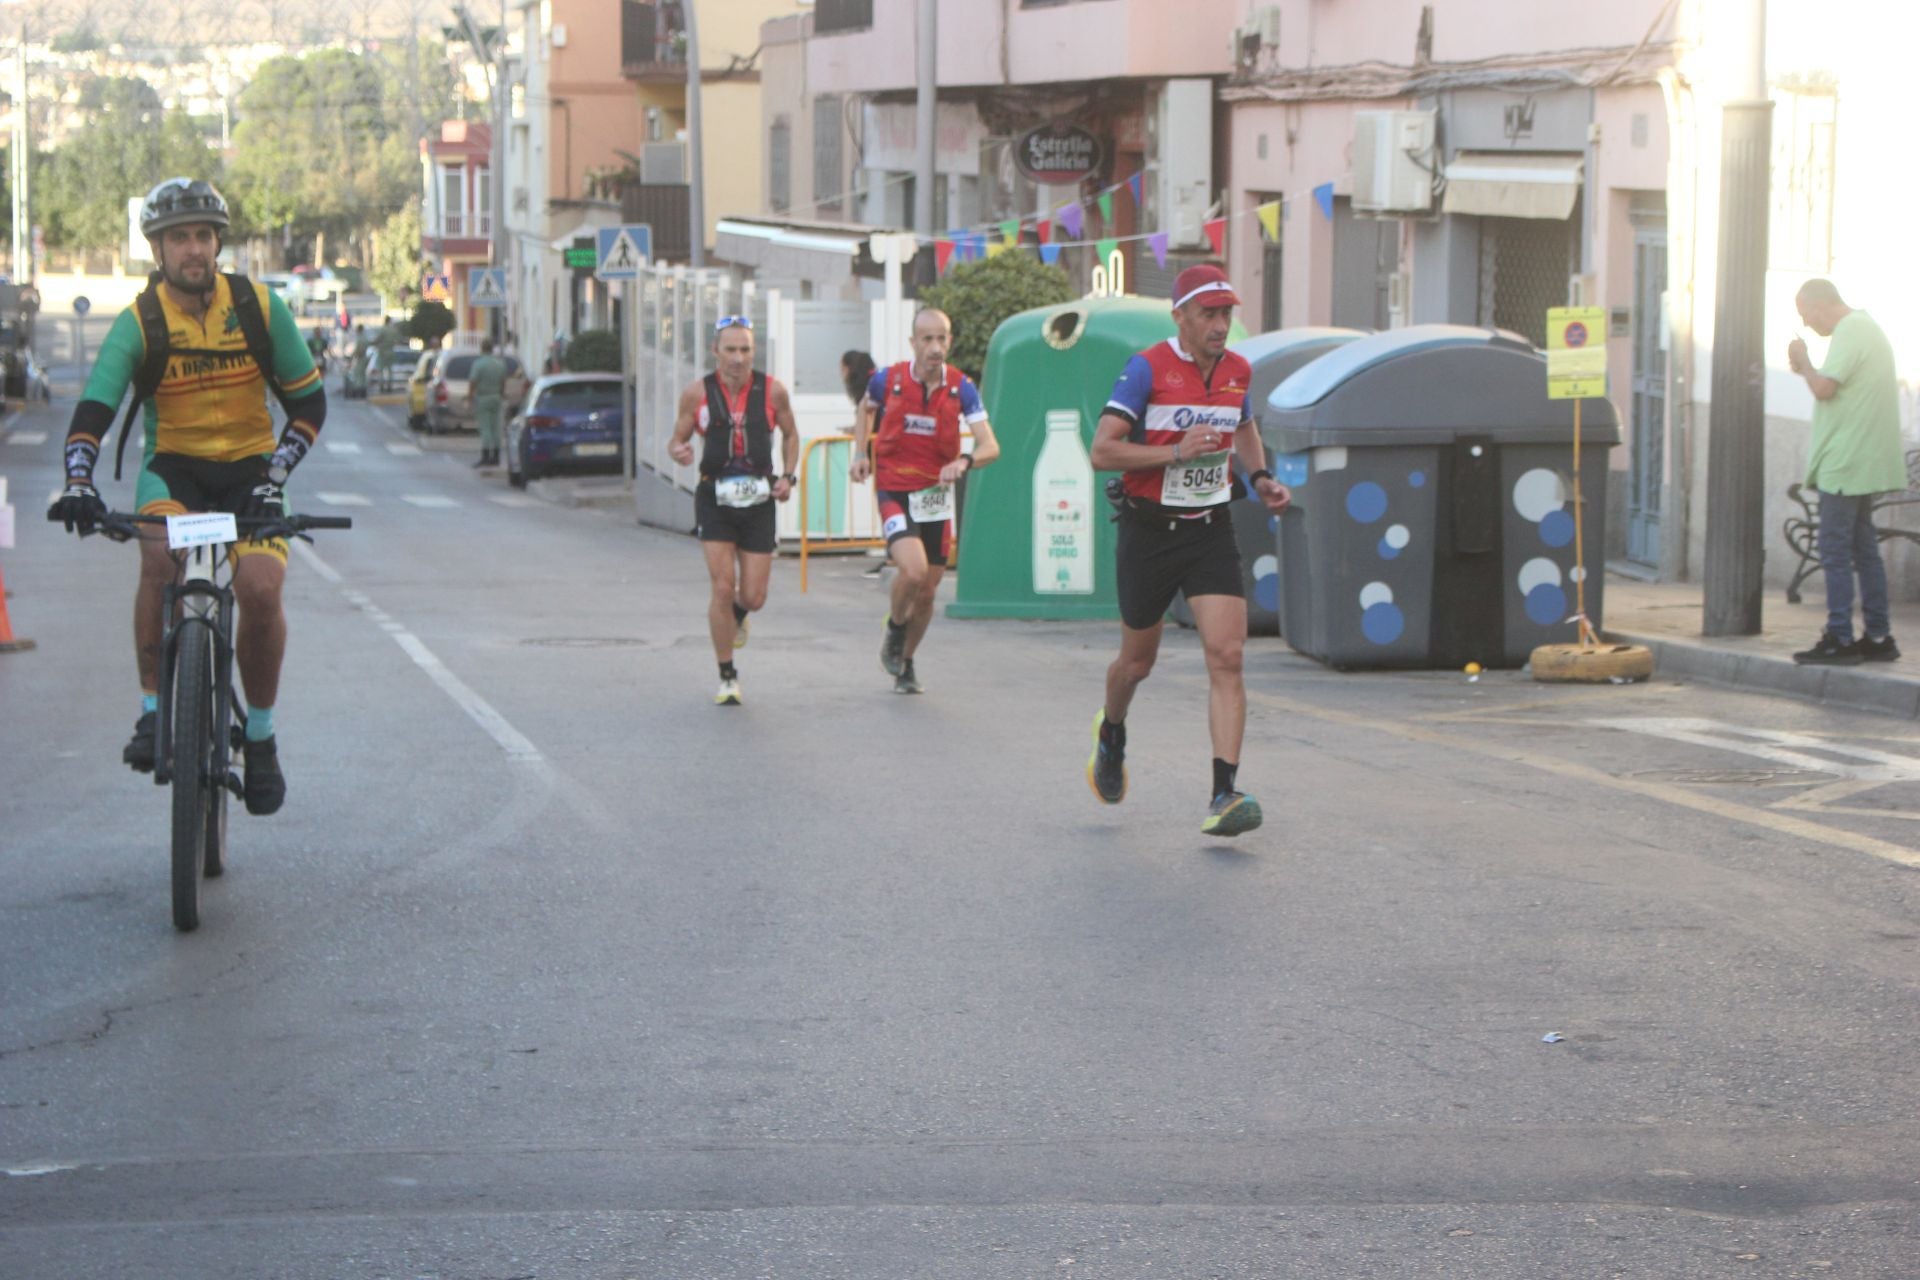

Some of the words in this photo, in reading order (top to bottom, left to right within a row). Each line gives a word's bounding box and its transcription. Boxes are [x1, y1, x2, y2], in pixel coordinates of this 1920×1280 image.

[1029, 134, 1092, 154] Estrella
[1030, 154, 1089, 171] Galicia
[1182, 466, 1223, 489] 5049
[734, 481, 758, 496] 790
